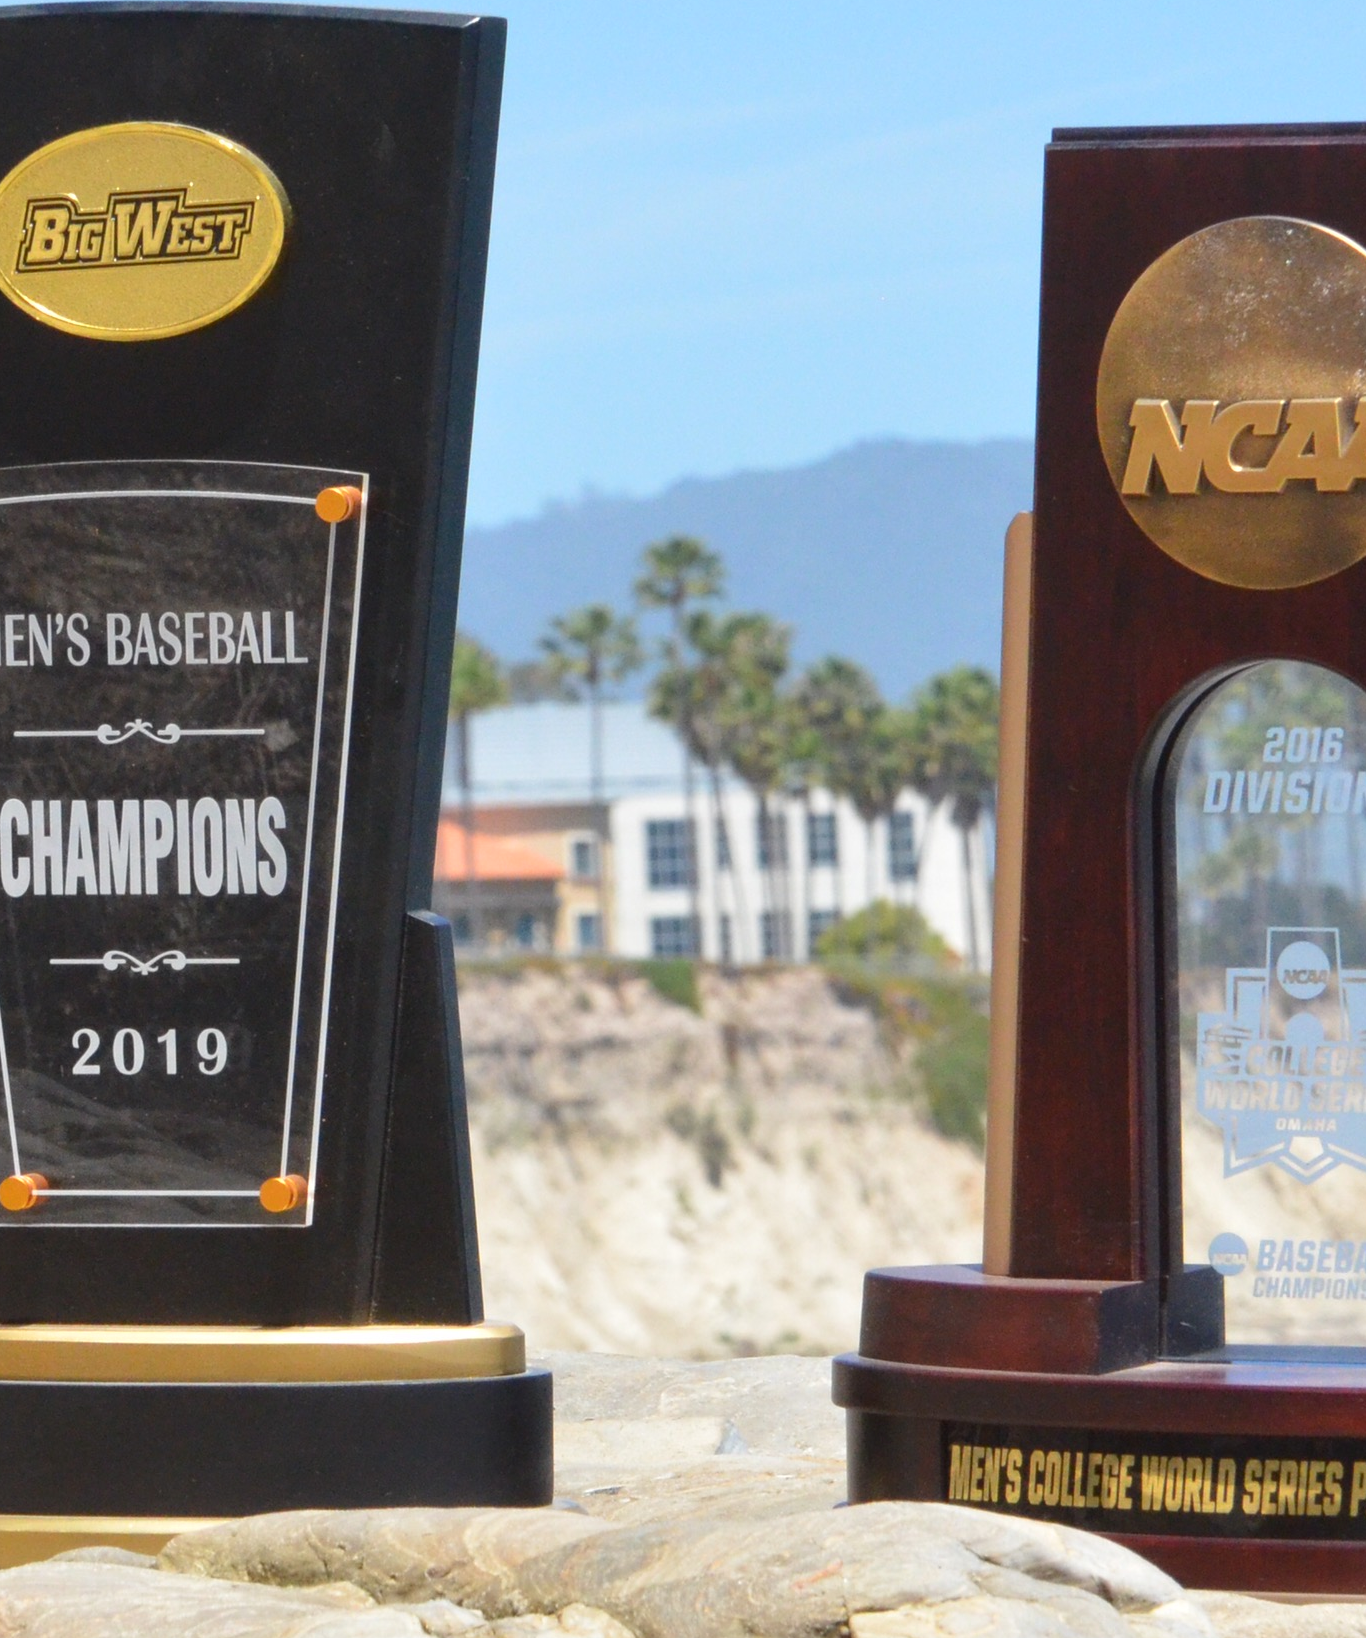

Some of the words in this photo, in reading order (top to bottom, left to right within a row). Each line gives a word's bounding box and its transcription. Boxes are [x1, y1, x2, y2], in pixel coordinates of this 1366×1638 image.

[106, 610, 309, 666] BASEBALL
[1262, 726, 1345, 763] 2016
[0, 797, 288, 897] CHAMPIONS
[1282, 968, 1329, 985] NCAA
[71, 1027, 229, 1076] 2019
[1244, 1045, 1364, 1076] COLLEGE
[1204, 1080, 1303, 1112] WORLD
[1275, 1117, 1337, 1131] OMAHA
[949, 1444, 1022, 1502] MEN'S
[1028, 1450, 1134, 1510] COLLEGE
[1141, 1455, 1236, 1514] WORLD
[1242, 1459, 1344, 1517] SERIES
